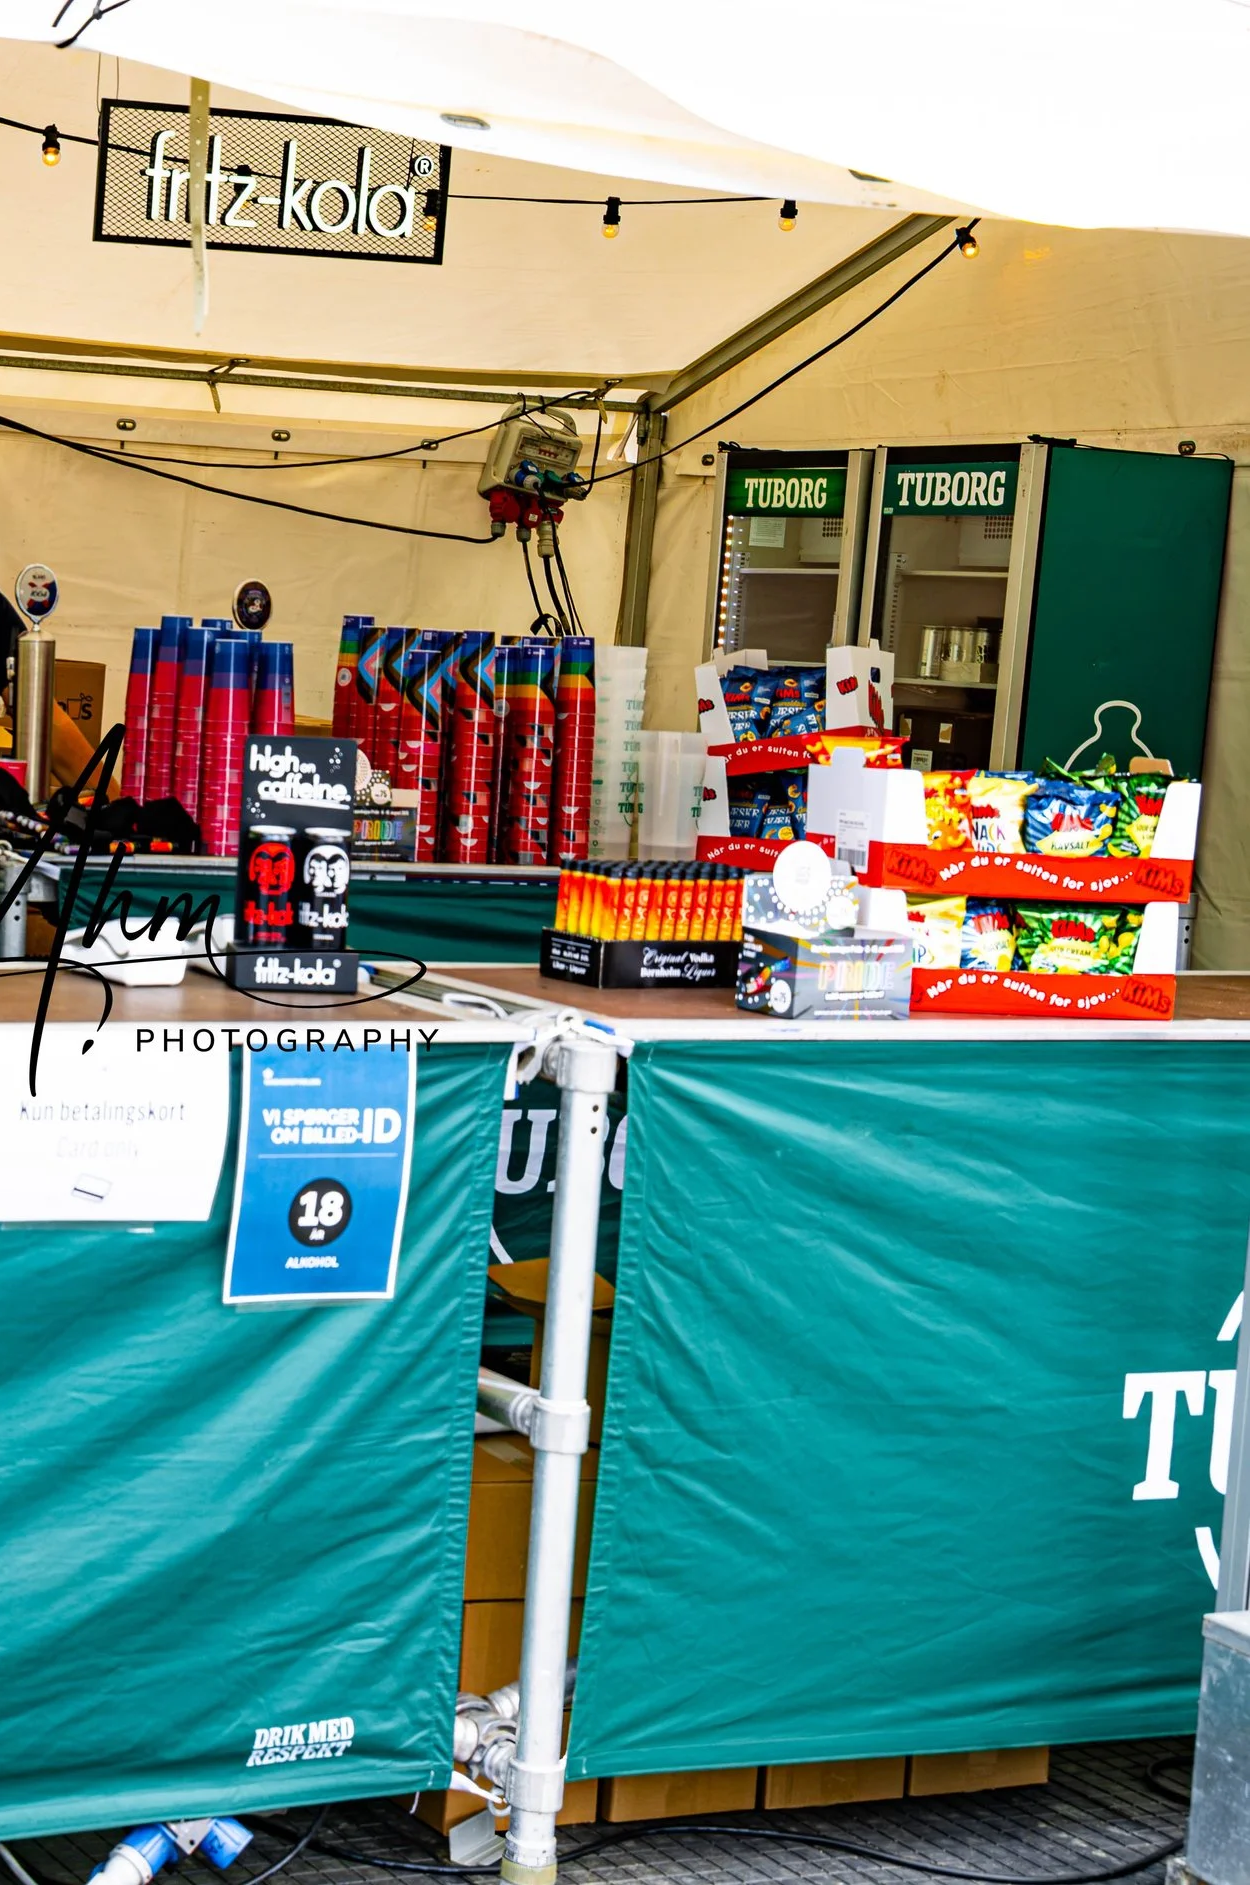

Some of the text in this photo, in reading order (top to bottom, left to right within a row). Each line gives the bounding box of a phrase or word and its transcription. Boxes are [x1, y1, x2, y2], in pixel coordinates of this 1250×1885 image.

[142, 129, 416, 239] frtz-kola
[745, 477, 827, 509] TUBORG
[897, 471, 1006, 507] TUBORG
[250, 744, 316, 778] high on
[736, 746, 748, 756] du
[767, 745, 799, 758] sulten
[257, 773, 351, 803] caffeine.
[353, 820, 403, 840] PRIDE
[707, 846, 725, 860] Når
[728, 843, 740, 851] du
[744, 843, 755, 851] er
[886, 851, 936, 887] KiMs
[939, 860, 966, 882] Når
[971, 856, 989, 867] du
[994, 856, 1011, 867] er
[1016, 860, 1058, 884] sulten
[1062, 876, 1084, 890] for
[1135, 861, 1184, 897] KiMs
[643, 947, 690, 965] Original
[254, 957, 336, 986] fritz-kola
[818, 961, 896, 991] PRIDE
[927, 979, 953, 999] Når
[958, 973, 977, 985] du
[981, 973, 999, 985] er
[1003, 978, 1046, 1002] sulten
[1050, 993, 1071, 1009] for
[1121, 978, 1172, 1015] KiMs
[19, 1099, 186, 1126] Kun betalingskort
[262, 1108, 281, 1126] VI
[270, 1127, 300, 1145] OM
[298, 1191, 344, 1227] 18
[285, 1255, 340, 1269] ALKOHOL
[253, 1717, 355, 1749] DRIK MED
[246, 1740, 352, 1767] RESPEKT
